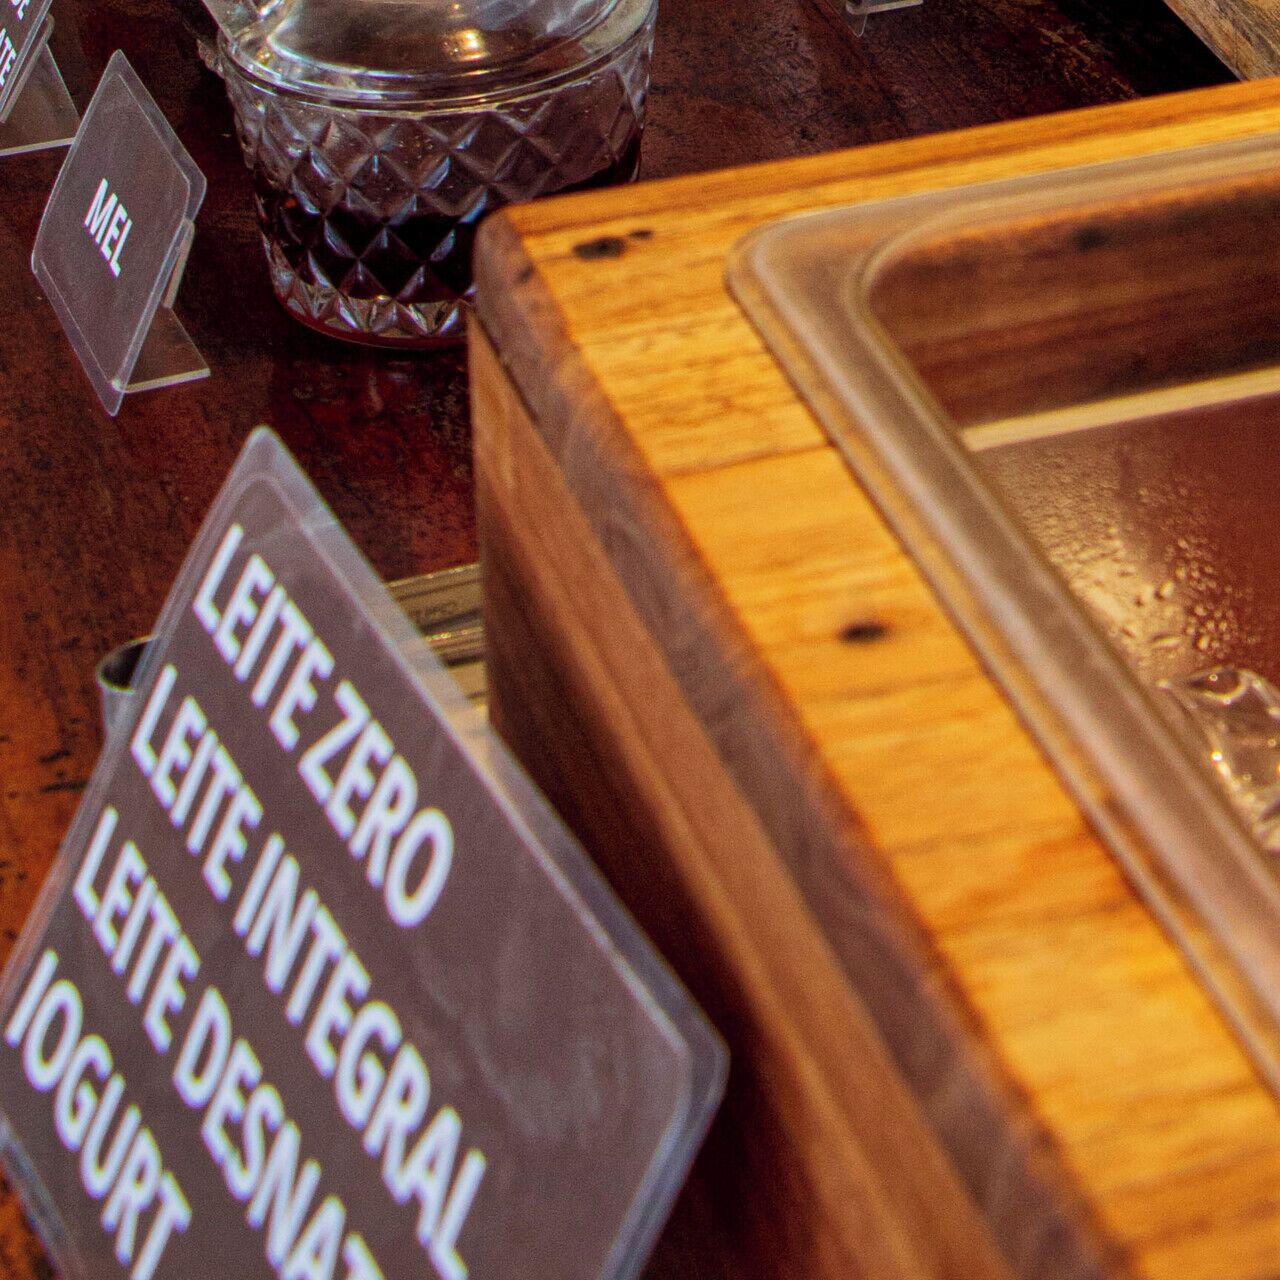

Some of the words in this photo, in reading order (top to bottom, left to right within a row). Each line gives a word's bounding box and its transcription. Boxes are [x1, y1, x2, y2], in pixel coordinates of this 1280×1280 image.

[83, 178, 133, 278] MEL
[193, 523, 336, 751] LEITE
[298, 681, 456, 929] ZERO
[72, 807, 201, 1054] LEITE
[129, 665, 264, 901] LEITE
[234, 833, 488, 1280] INTEGRAL
[4, 948, 193, 1280] IOGURT
